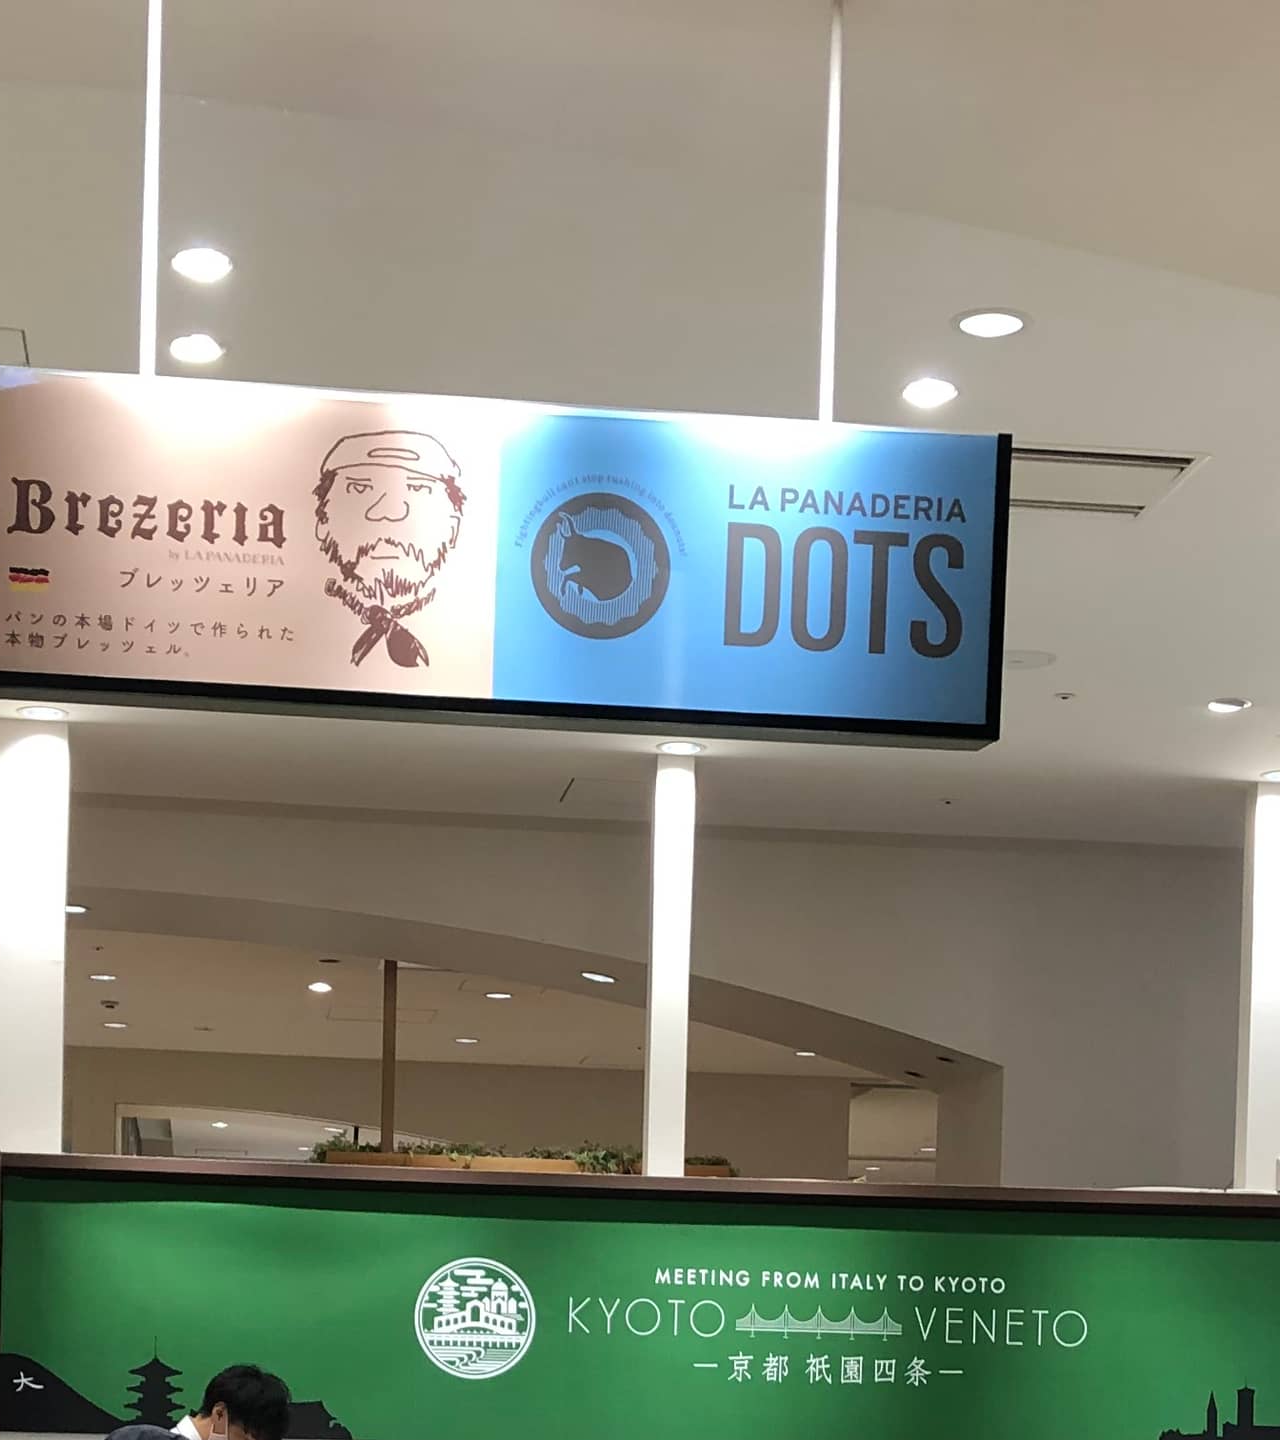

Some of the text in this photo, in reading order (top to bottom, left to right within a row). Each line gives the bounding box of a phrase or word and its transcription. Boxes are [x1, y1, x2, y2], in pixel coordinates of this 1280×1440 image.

[6, 476, 287, 549] Brezeria
[727, 484, 967, 523] LA PANADERIA
[119, 567, 285, 598] ブレッツェリア
[723, 521, 965, 659] DOTS
[654, 1267, 1005, 1294] MEETING FROM ITALY TO KYOTO
[568, 1297, 1088, 1347] KYOTO VENETO
[12, 1371, 44, 1392] 大
